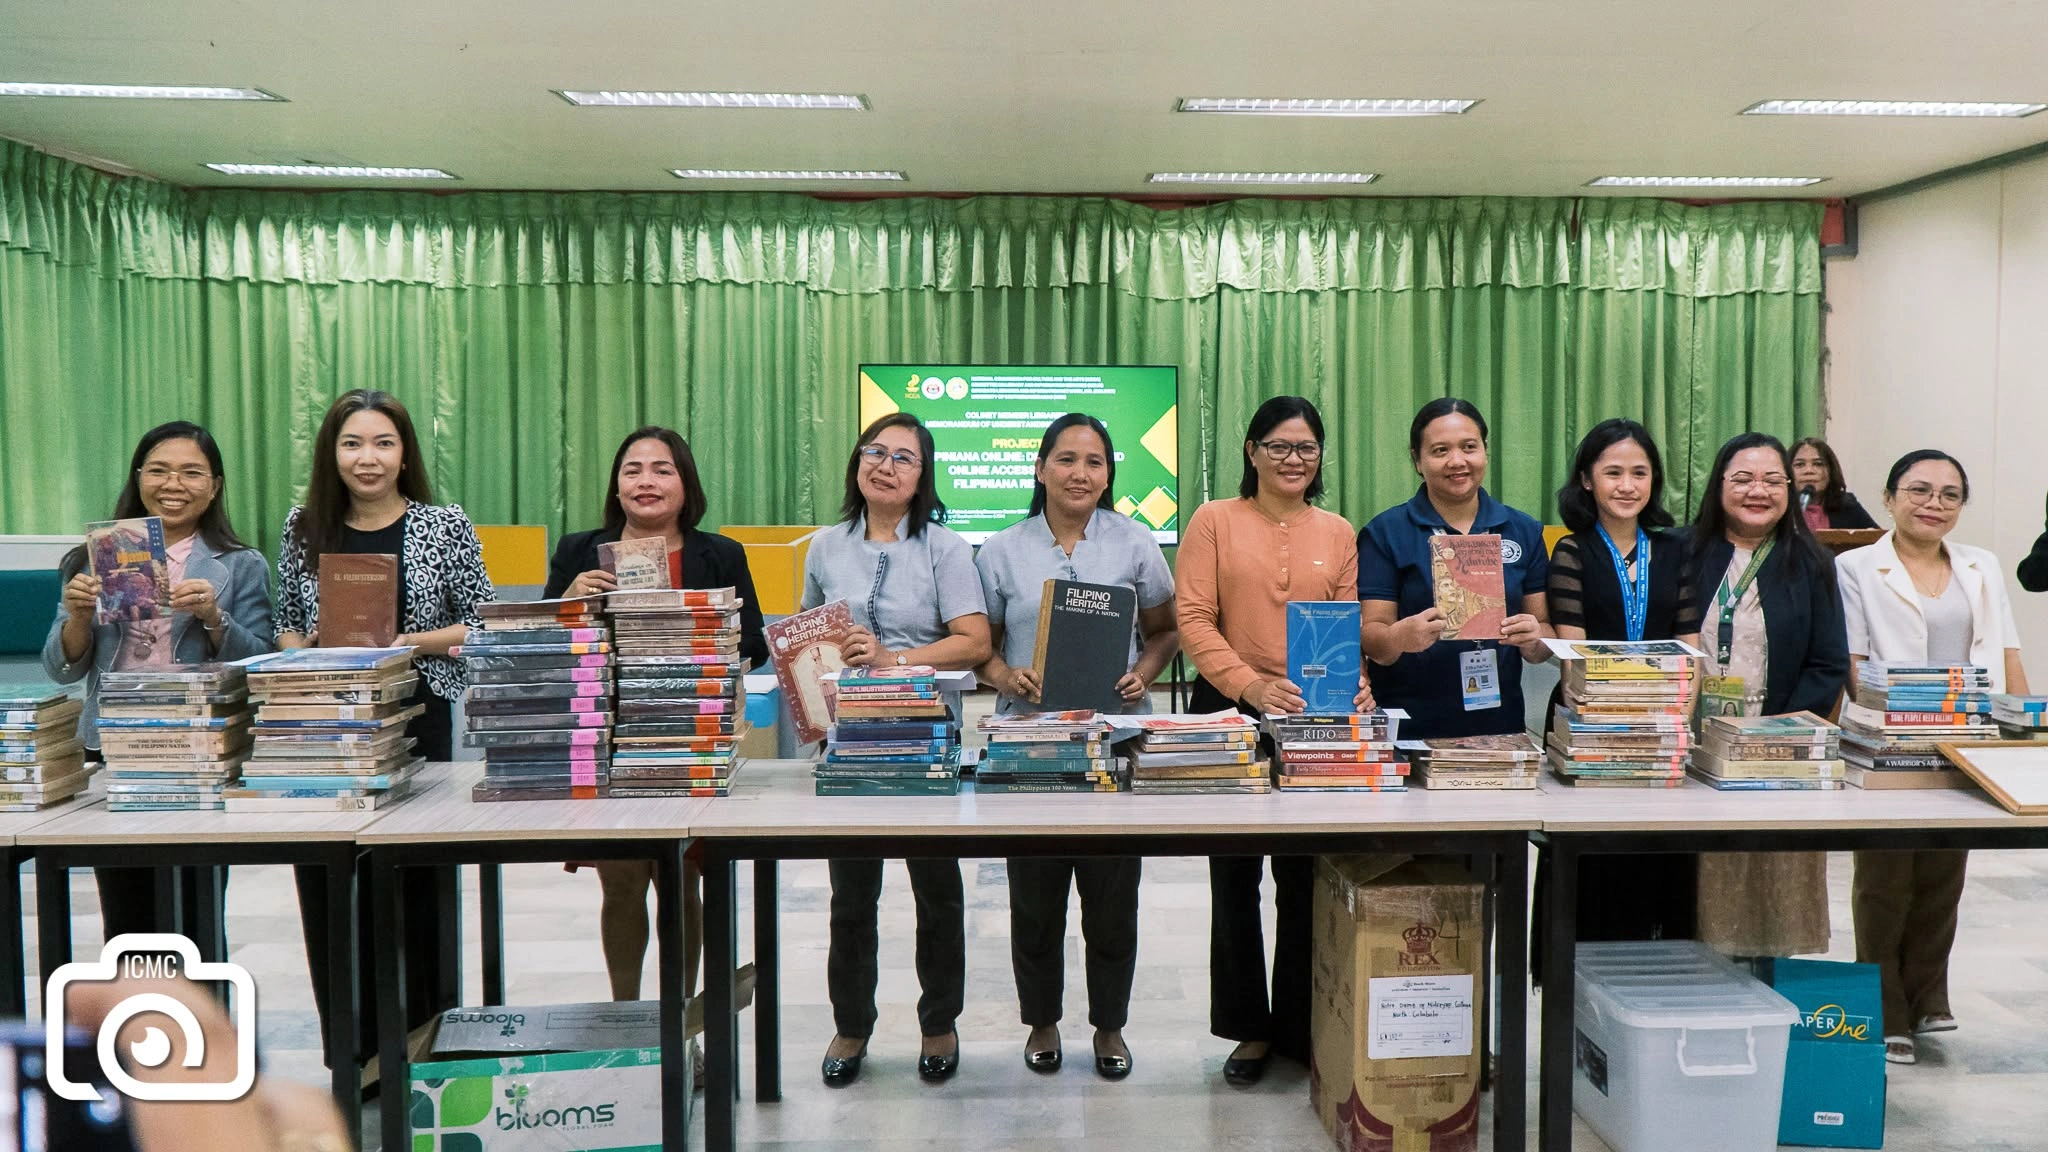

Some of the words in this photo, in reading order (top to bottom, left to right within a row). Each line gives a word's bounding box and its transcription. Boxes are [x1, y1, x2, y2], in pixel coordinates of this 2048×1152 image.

[925, 420, 981, 428] MEMORANDUM
[982, 420, 991, 428] OF
[934, 451, 980, 462] PINIANA
[981, 451, 1025, 462] ONLINE:
[948, 465, 990, 476] ONLINE
[991, 465, 1035, 476] ACCESS
[954, 479, 1018, 489] FILIPINIANA
[1066, 588, 1111, 602] FILIPINO
[1065, 598, 1110, 611] HERITAGE
[785, 615, 827, 636] FILIPINO
[788, 623, 831, 645] HERITAGE
[791, 641, 810, 649] MAKING
[824, 629, 842, 637] NATION
[1891, 713, 1903, 722] SOME
[1904, 713, 1921, 722] PEOPLE
[1922, 713, 1934, 722] NEED
[1935, 713, 1953, 722] KILLING
[1303, 729, 1336, 740] RIDO
[1287, 751, 1334, 760] Viewpoints
[1398, 950, 1440, 965] REX
[446, 1013, 525, 1029] blooms
[1795, 1016, 1835, 1029] APER
[1812, 1003, 1871, 1041] One
[496, 1100, 615, 1131] blooms
